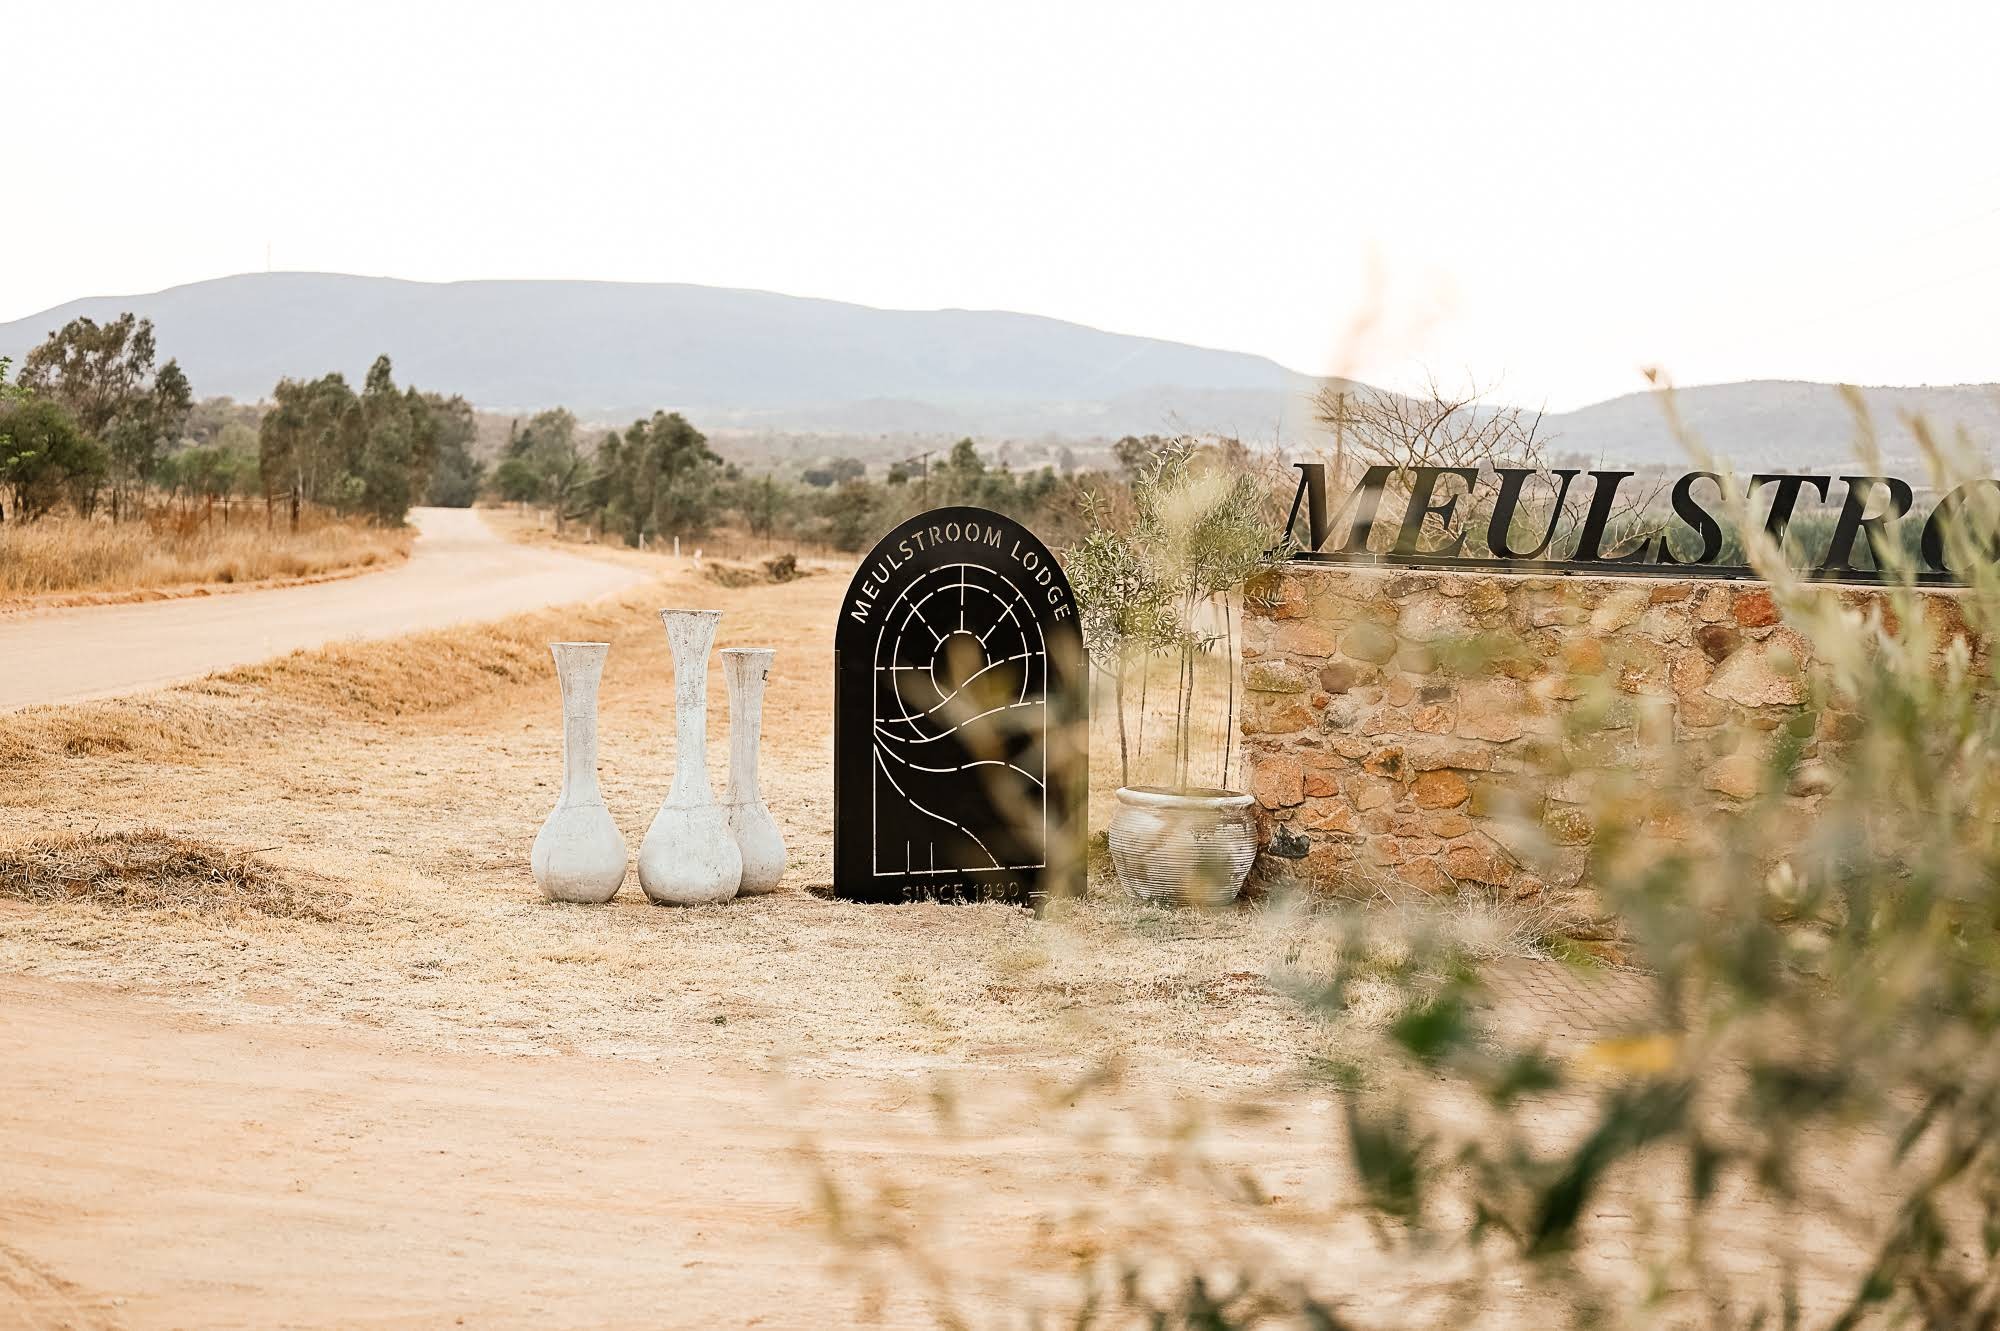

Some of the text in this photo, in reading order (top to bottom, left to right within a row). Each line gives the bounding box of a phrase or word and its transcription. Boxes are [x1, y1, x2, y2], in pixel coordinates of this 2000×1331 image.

[850, 522, 1071, 624] MEULSTROOM LODGE
[901, 883, 963, 901] SINCE
